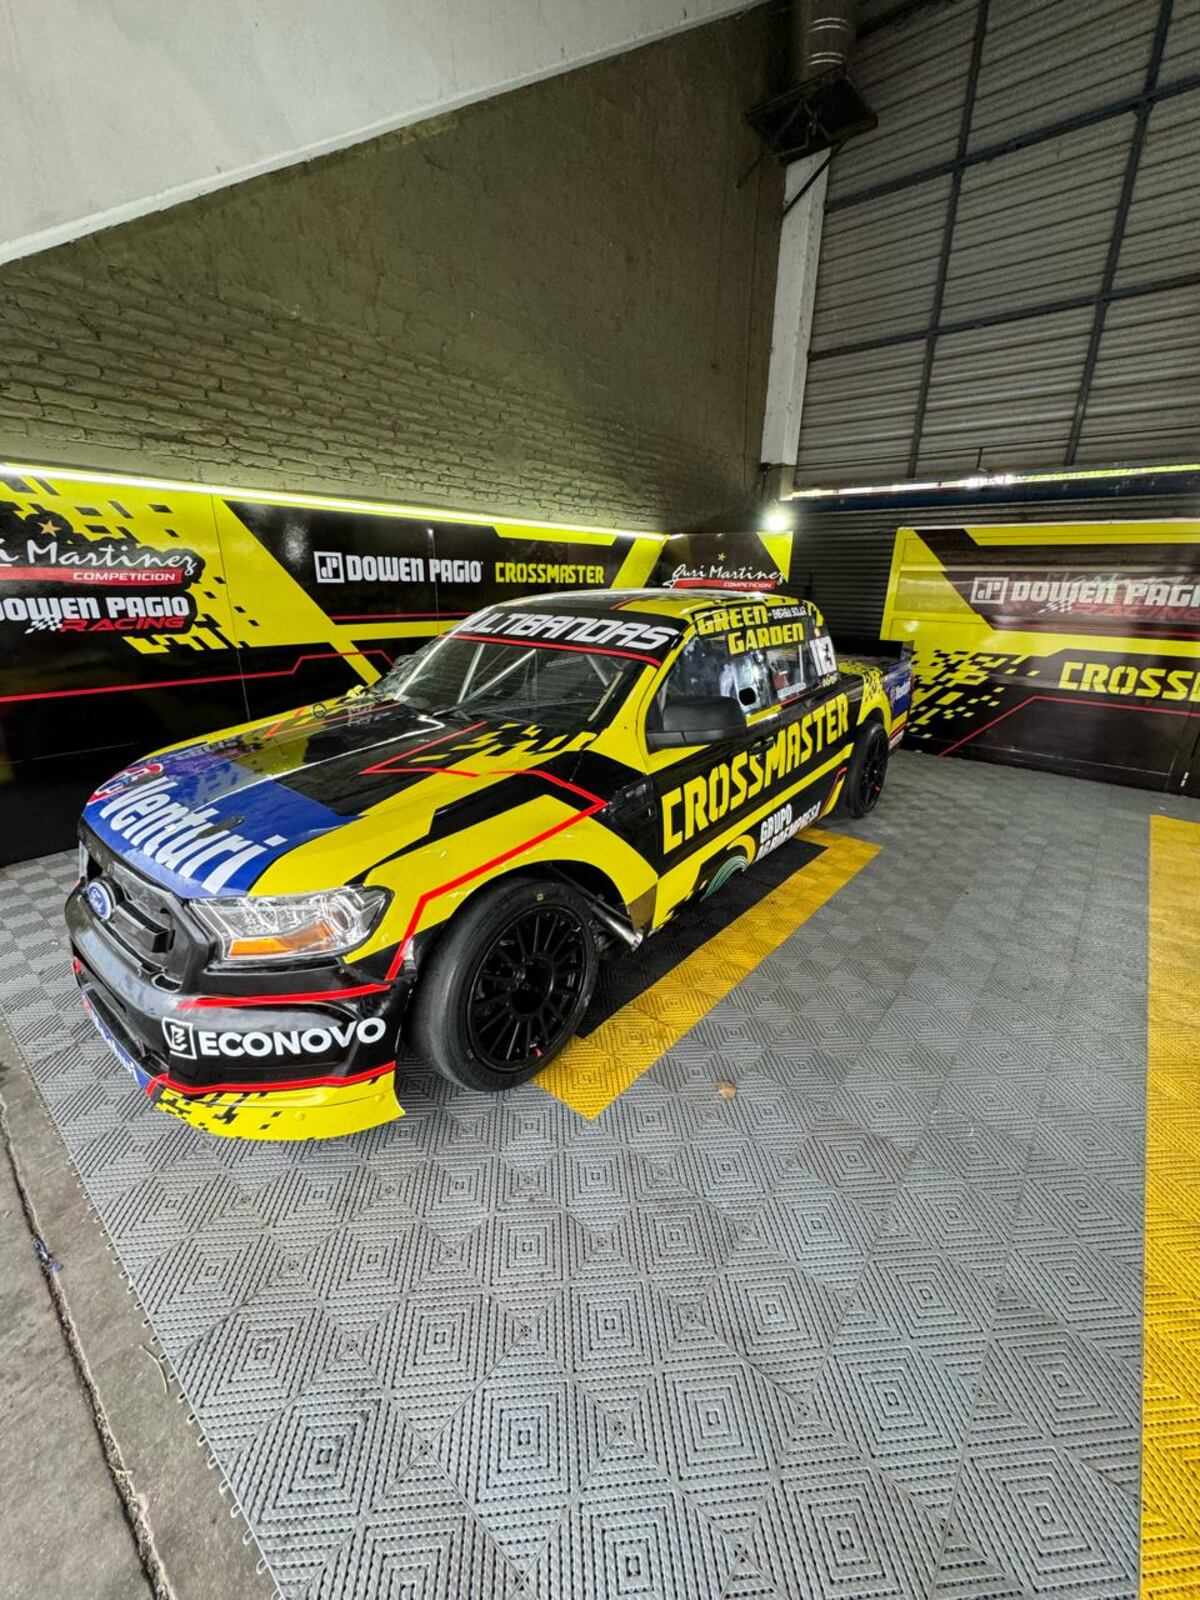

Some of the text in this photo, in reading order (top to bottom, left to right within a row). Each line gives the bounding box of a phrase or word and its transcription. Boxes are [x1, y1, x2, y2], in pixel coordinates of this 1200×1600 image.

[27, 540, 197, 576] Martinez
[346, 555, 424, 582] DOWEN
[429, 559, 482, 583] PAGIO
[495, 562, 605, 584] CROSSMASTER
[73, 571, 175, 582] COMPETICION
[709, 565, 785, 585] Martinez
[0, 597, 189, 621] OWEN PAGIO
[694, 605, 769, 635] GREEN
[60, 617, 186, 633] RACING
[728, 623, 804, 655] GARDEN
[661, 693, 848, 854] CROSSMASTER
[99, 777, 288, 894] Venturi
[760, 803, 793, 844] GRUPO
[198, 1017, 386, 1057] ECONOVO
